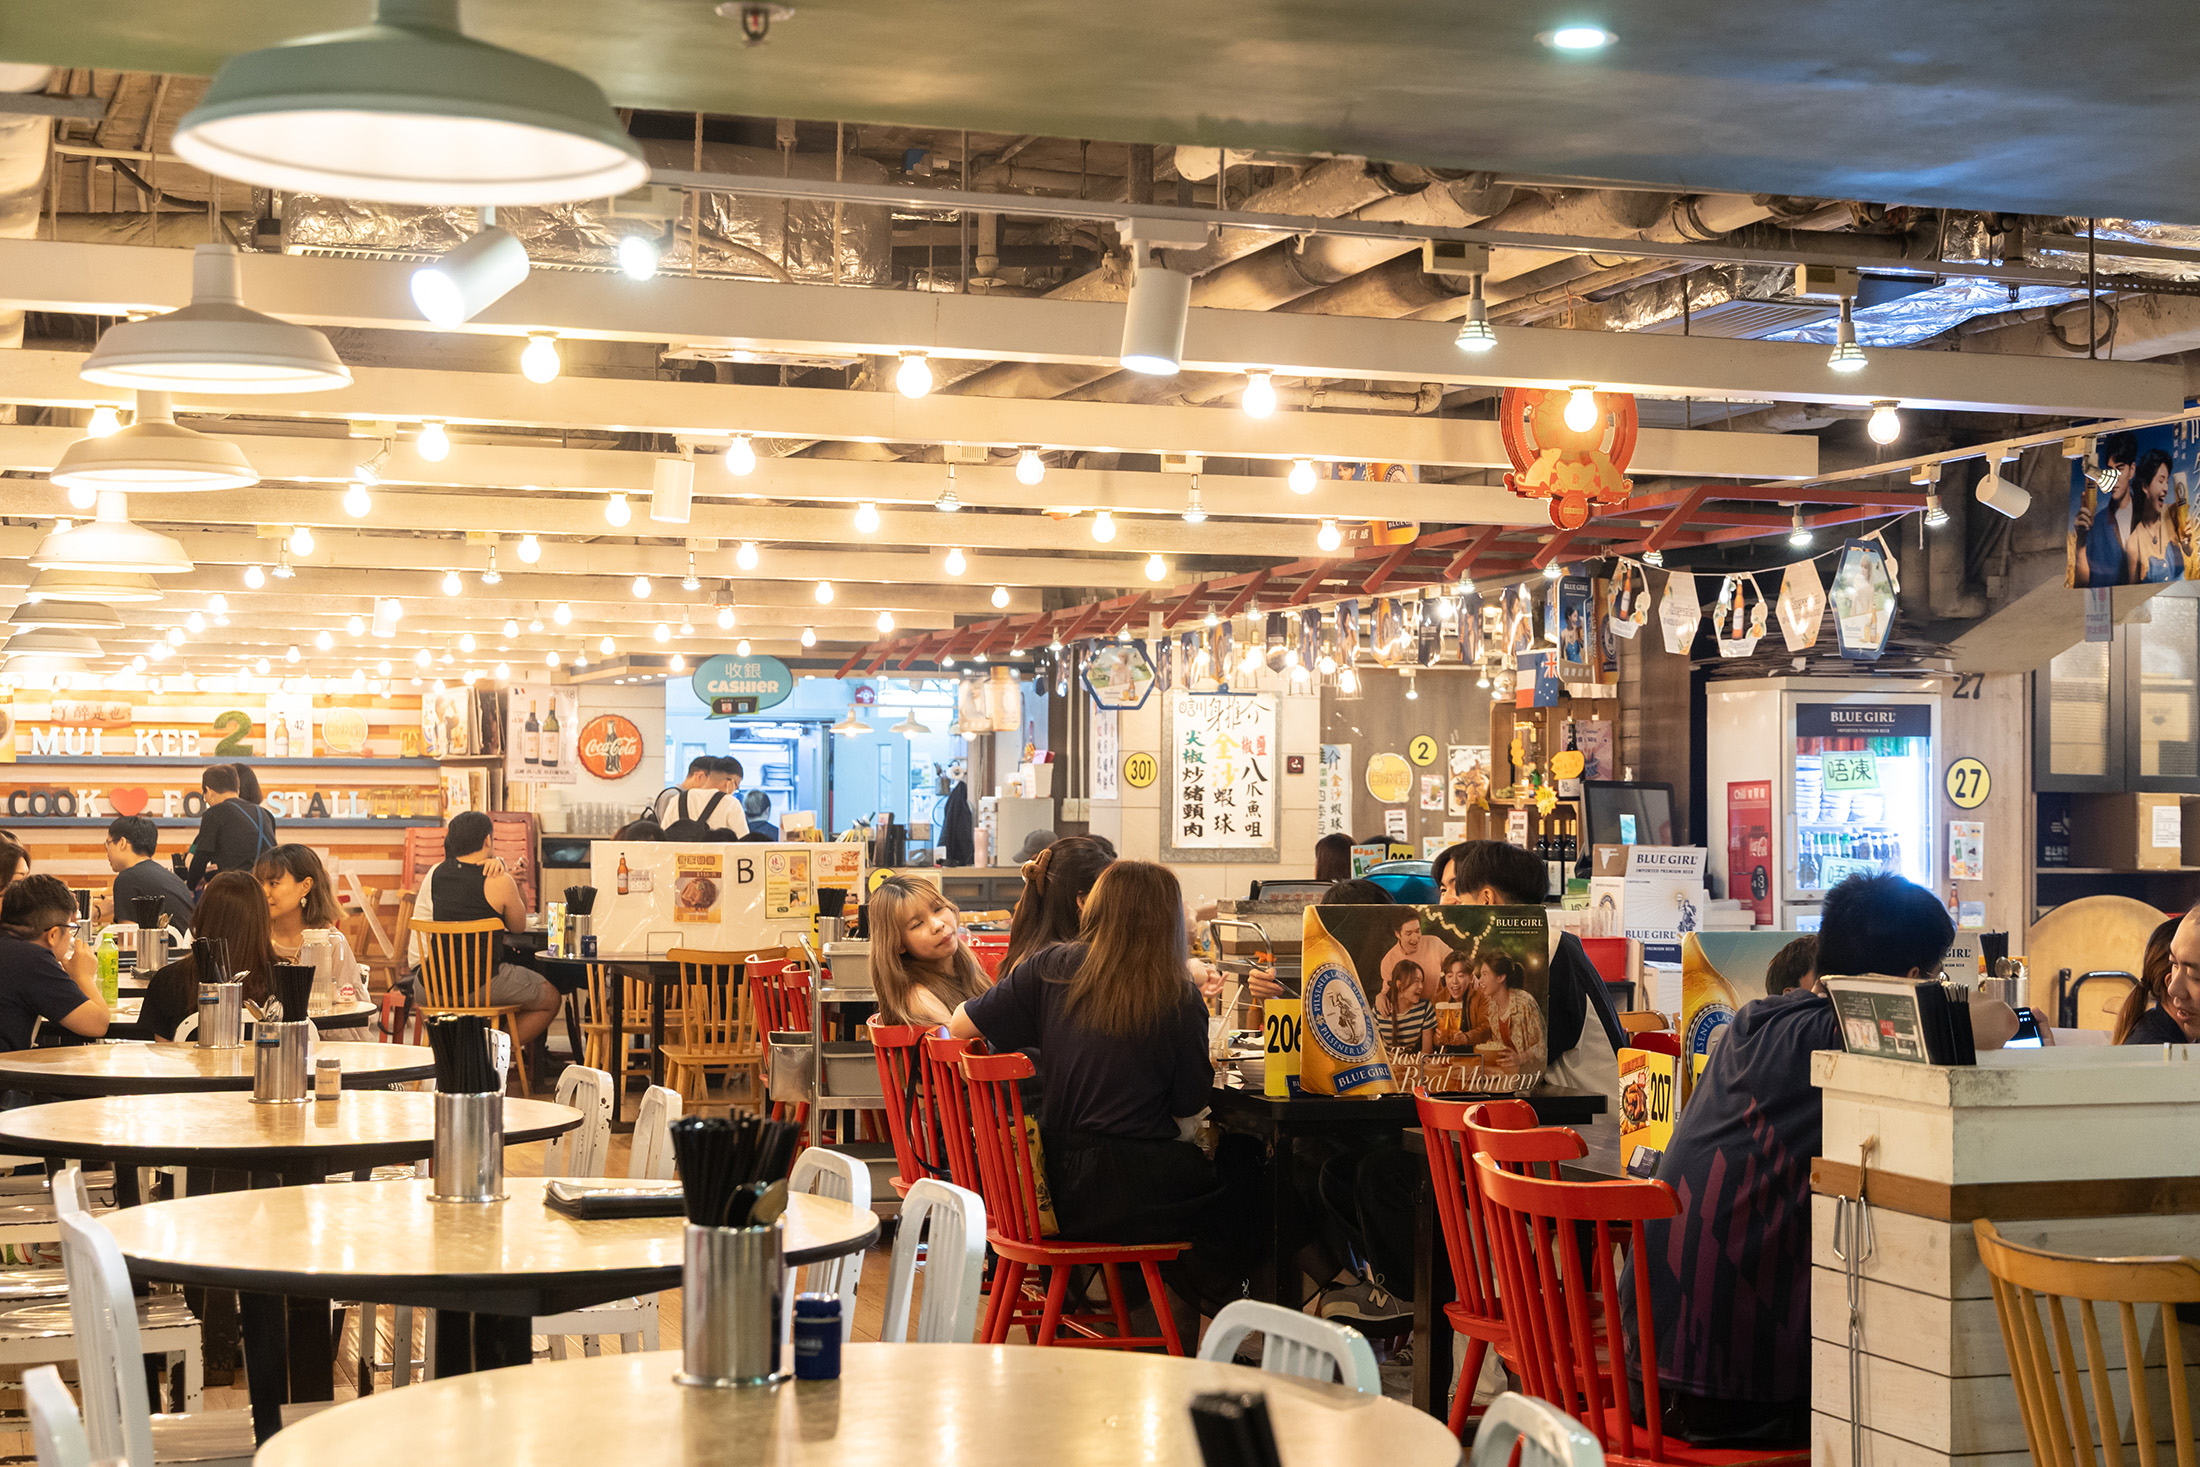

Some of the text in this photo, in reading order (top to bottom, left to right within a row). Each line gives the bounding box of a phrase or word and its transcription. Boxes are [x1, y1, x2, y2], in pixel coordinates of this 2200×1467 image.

[725, 662, 762, 679] 收銀
[1952, 672, 1986, 699] 27
[1830, 712, 1896, 722] BLUE GIRL
[30, 727, 200, 757] MUI KEE
[213, 710, 254, 757] 2
[1417, 742, 1429, 760] 2
[1131, 760, 1151, 780] 301
[1211, 732, 1241, 835] 金沙蝦球
[1828, 758, 1872, 782] 唔凍
[1955, 768, 1981, 798] 27
[8, 790, 207, 819] COOK FO
[266, 790, 368, 818] STALL
[1330, 773, 1344, 830] 金沙蝦球
[737, 858, 754, 884] B
[1636, 854, 1697, 865] BLUE GIRL
[1496, 919, 1543, 927] BLUE GIRL
[1625, 930, 1676, 940] BLUE GIRL
[1314, 971, 1331, 1013] PILSENER
[1331, 970, 1354, 987] LAGER
[1320, 1026, 1357, 1056] PILSENER
[1356, 1034, 1373, 1055] LAGER
[1391, 1046, 1455, 1066] Tast the
[1337, 1066, 1391, 1088] BLUE GIRL
[1400, 1065, 1543, 1093] Real Moment
[1650, 1071, 1672, 1124] 207
